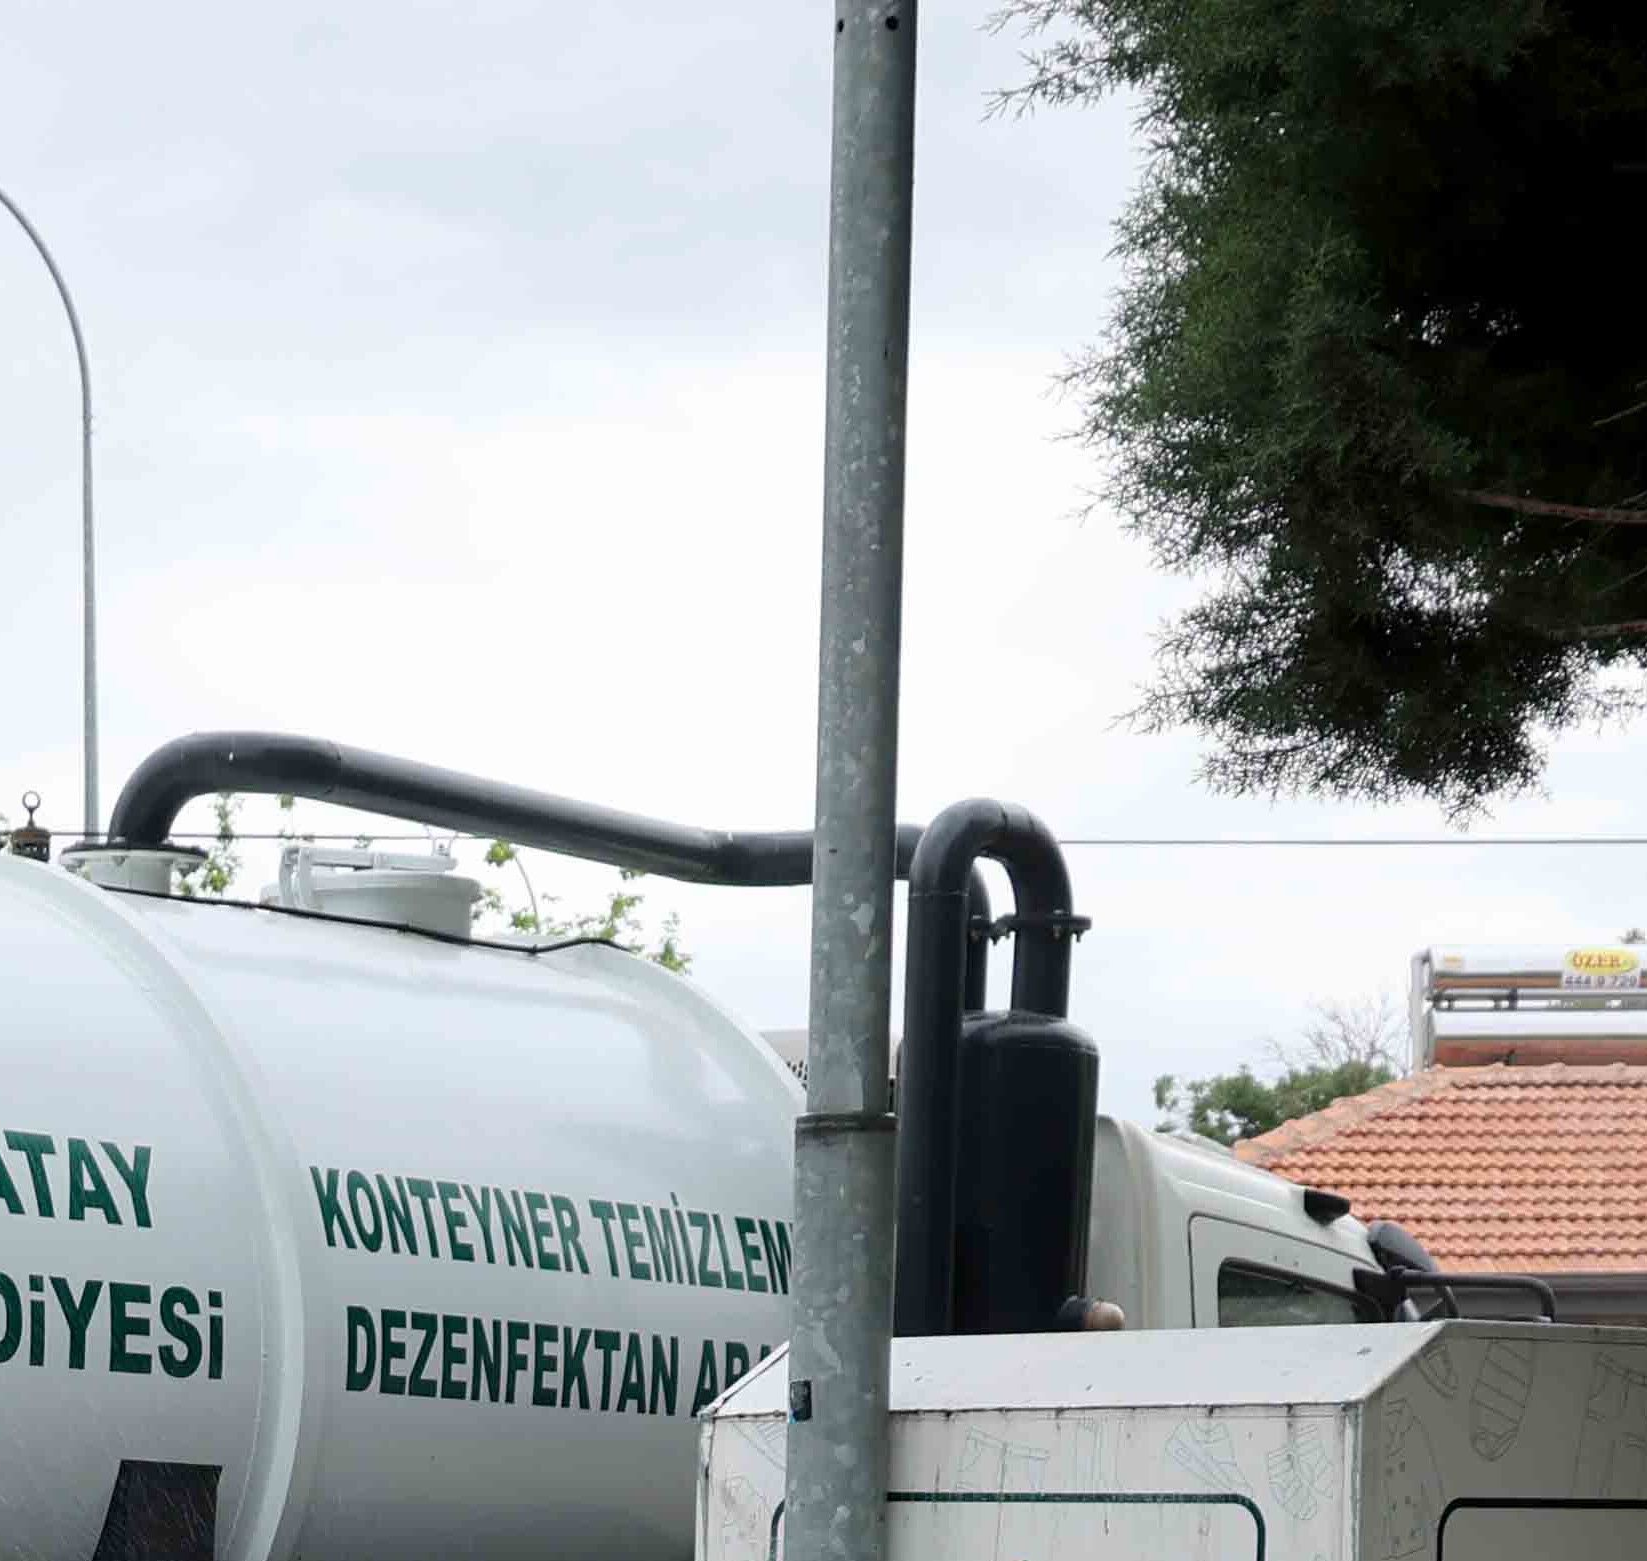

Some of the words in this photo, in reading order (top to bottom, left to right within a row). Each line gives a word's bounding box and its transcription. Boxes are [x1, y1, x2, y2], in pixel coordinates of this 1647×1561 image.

[309, 1165, 591, 1275] KONTEYNER
[345, 1305, 680, 1418] DEZENFEKTAN
[690, 1339, 773, 1418] AR
